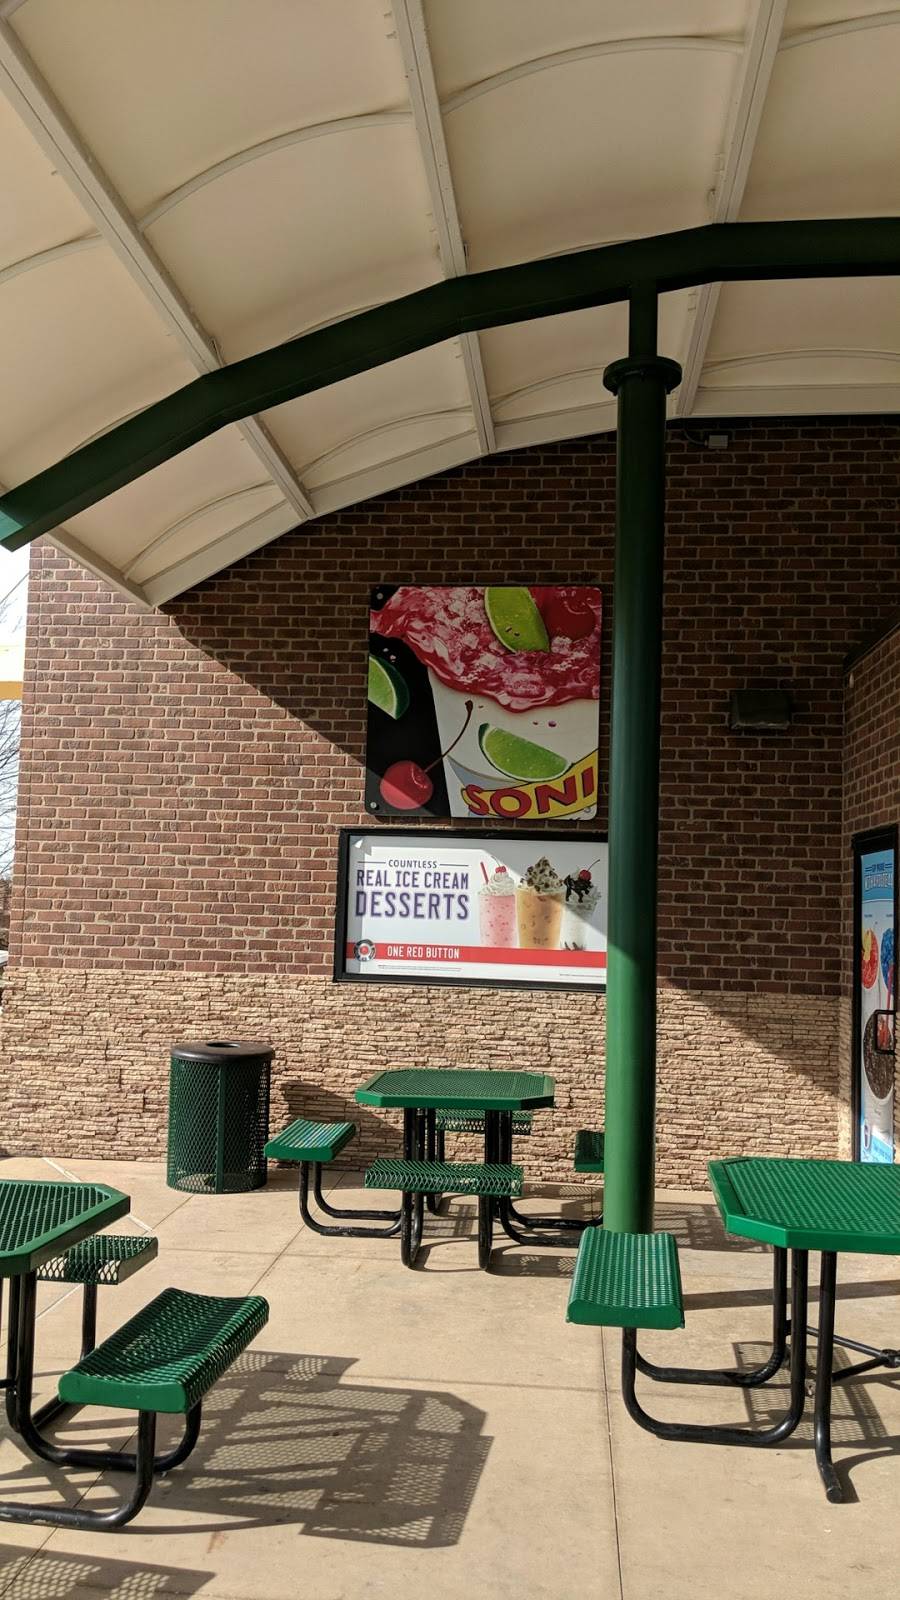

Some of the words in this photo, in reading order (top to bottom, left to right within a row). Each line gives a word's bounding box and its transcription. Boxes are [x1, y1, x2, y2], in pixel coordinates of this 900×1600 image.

[388, 859, 438, 869] COUNTLESS
[356, 870, 391, 887] REAL
[395, 870, 420, 888] ICE
[424, 872, 469, 889] CREAM
[355, 890, 469, 920] DESSERTS
[387, 945, 404, 957] ONE
[406, 946, 424, 958] RED
[425, 947, 460, 959] BUTTON
